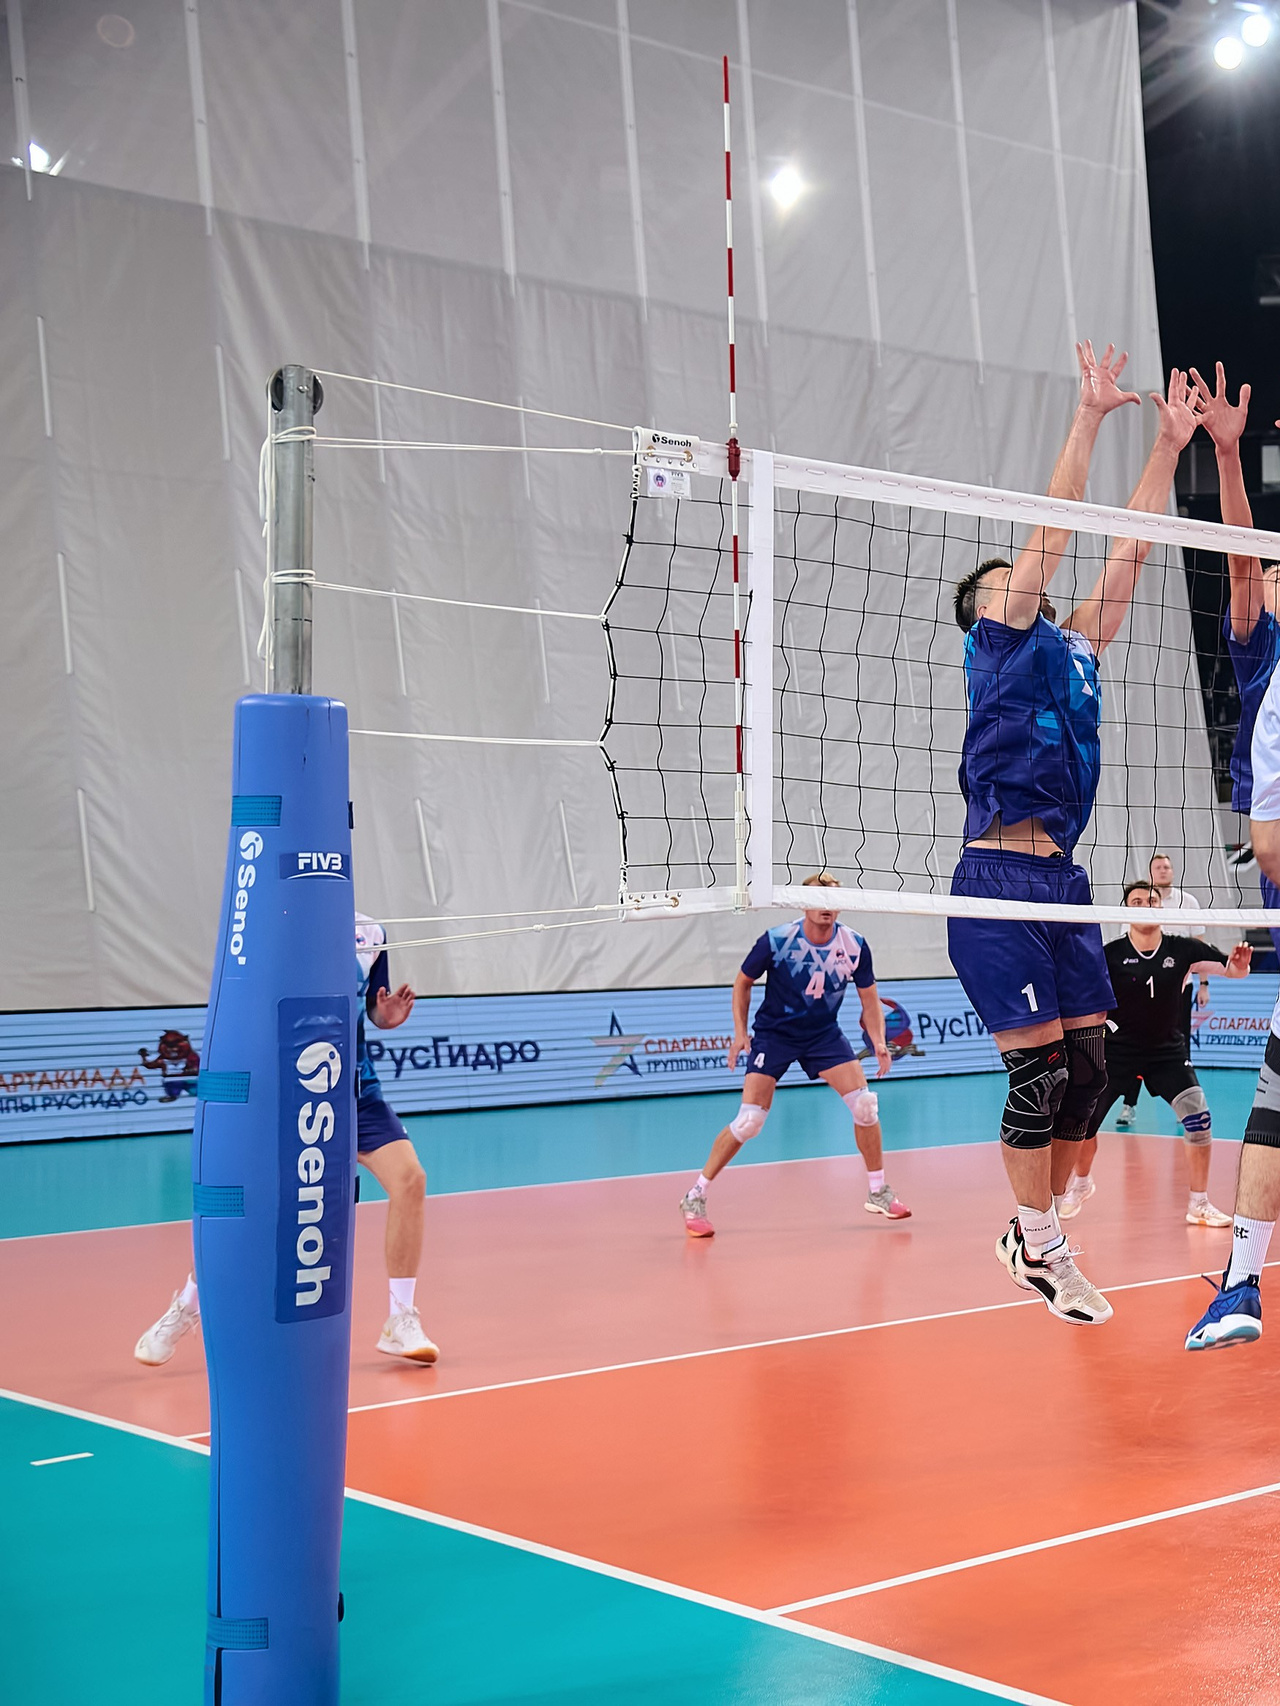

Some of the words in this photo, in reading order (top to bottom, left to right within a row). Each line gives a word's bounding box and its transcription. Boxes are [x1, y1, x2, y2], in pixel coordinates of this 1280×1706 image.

[661, 436, 692, 448] Senoh
[298, 852, 343, 870] FIVB
[804, 971, 825, 999] 4
[1146, 975, 1154, 998] 1
[1021, 983, 1038, 1013] 1
[366, 1036, 541, 1079] РусГидро
[647, 1058, 701, 1073] ГРУППЫ
[753, 1052, 765, 1069] 4
[42, 1088, 150, 1112] РУСГИДРО
[296, 1100, 335, 1307] Senoh
